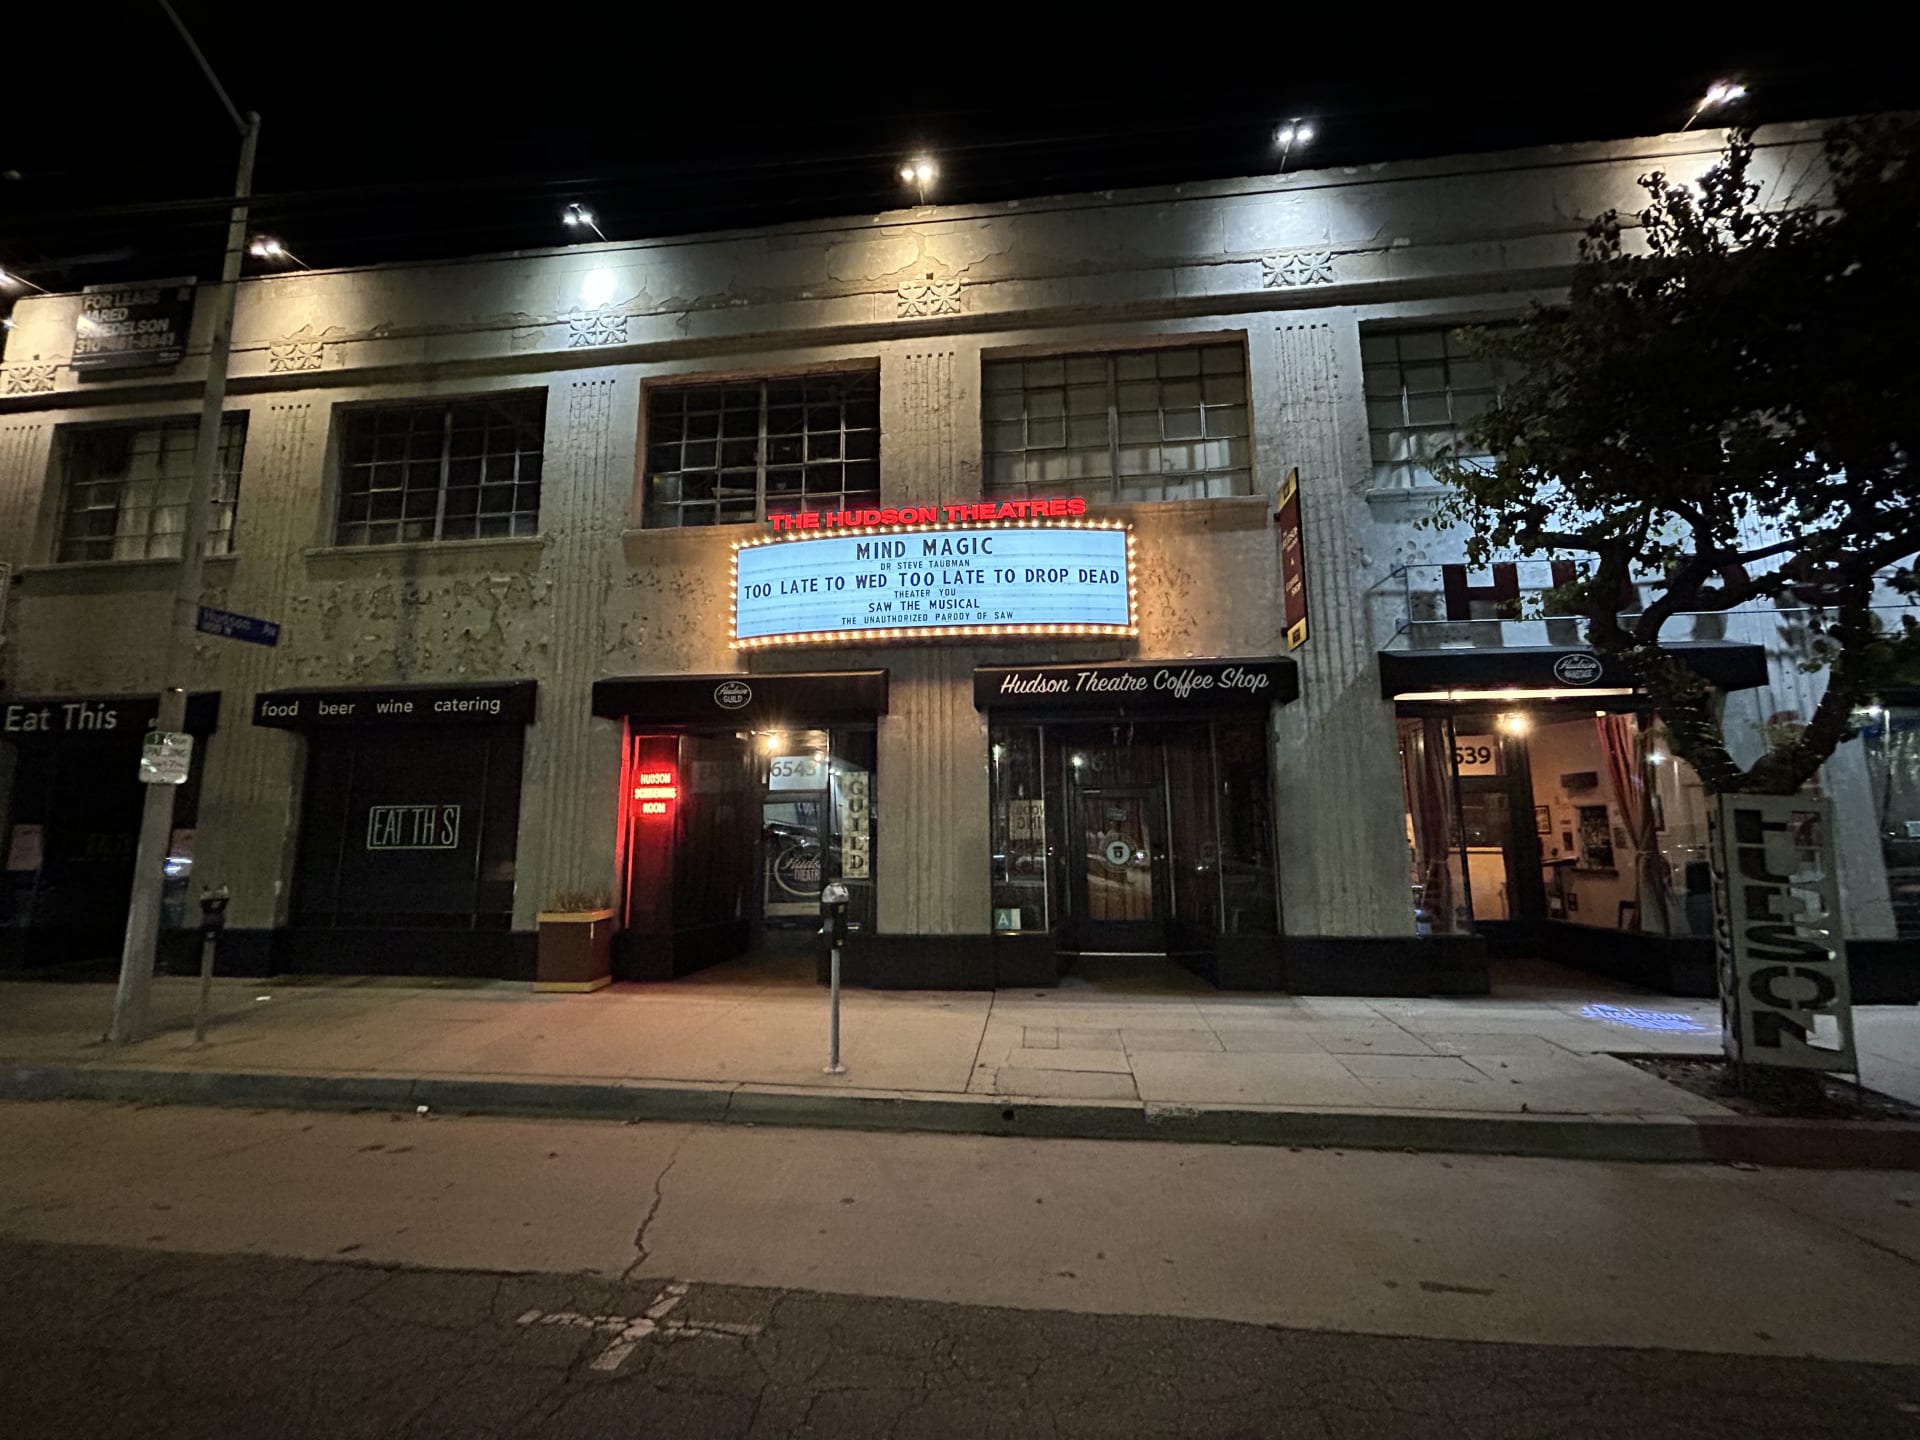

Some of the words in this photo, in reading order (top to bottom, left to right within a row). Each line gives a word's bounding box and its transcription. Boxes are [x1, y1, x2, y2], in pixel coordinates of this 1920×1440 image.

[83, 294, 113, 310] FOR
[116, 290, 160, 306] LEASE
[768, 512, 820, 530] THE
[826, 506, 938, 528] HUDSON
[942, 497, 1087, 521] THEATRES
[856, 540, 907, 560] MIND
[922, 537, 993, 557] MAGIC
[880, 563, 892, 571] DR
[897, 561, 923, 570] STEVE
[928, 559, 971, 568] TAUBMAN
[744, 583, 772, 600] TOO
[780, 578, 818, 595] LATE
[825, 576, 845, 591] TO
[856, 574, 887, 589] WED
[899, 572, 935, 587] TOO
[943, 569, 984, 585] LATE
[994, 568, 1015, 584] TO
[1025, 568, 1069, 583] DROP
[1079, 569, 1120, 584] DEAD
[894, 589, 931, 599] THEATER
[939, 588, 956, 597] YOU
[869, 602, 892, 613] SAW
[900, 600, 921, 611] THE
[929, 599, 980, 610] MUSICAL
[842, 617, 857, 625] THE
[864, 614, 928, 624] UNAUTHORIZED
[935, 612, 970, 621] PARODY
[977, 612, 988, 620] OF
[994, 611, 1014, 620] SAW
[1000, 673, 1071, 694] Hudson
[1074, 671, 1148, 692] Theatre
[1153, 669, 1214, 698] Coffee
[1217, 667, 1270, 694] Shop
[261, 700, 299, 716] food
[318, 700, 355, 716] beer
[376, 699, 414, 714] wine
[434, 696, 501, 714] catering
[5, 704, 51, 731] Eat
[62, 702, 118, 730] This
[640, 772, 671, 785] HUDSON
[642, 802, 666, 814] ROOM
[373, 809, 407, 845] EAT
[411, 808, 455, 845] THS
[850, 780, 865, 870] GUILD
[998, 912, 1009, 926] A
